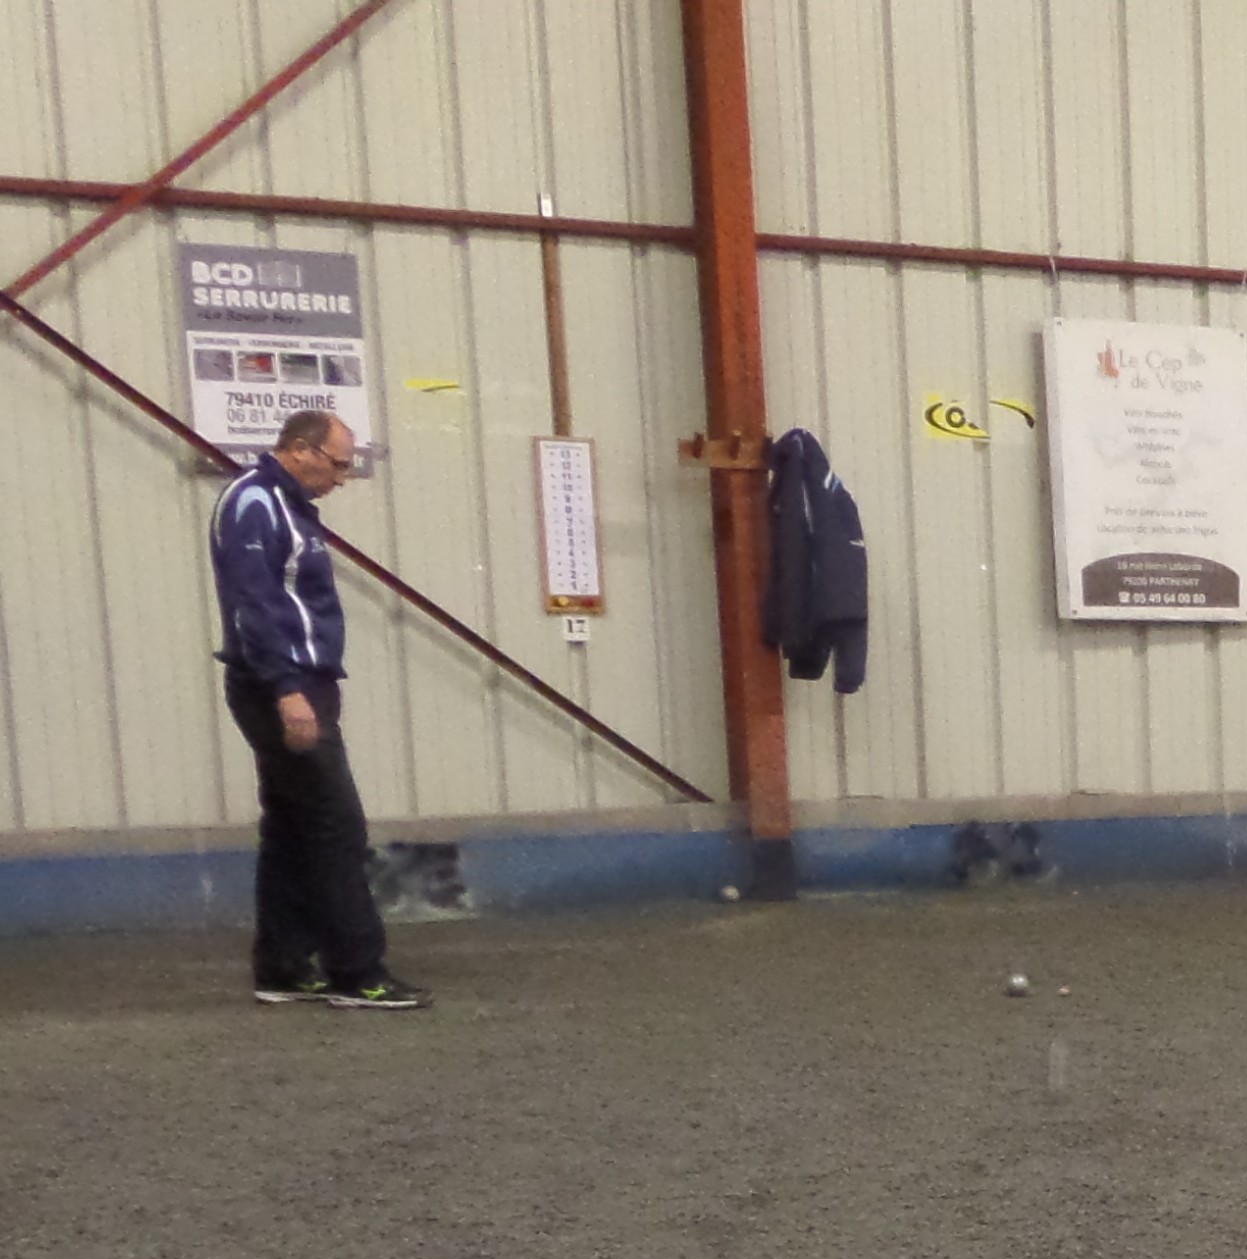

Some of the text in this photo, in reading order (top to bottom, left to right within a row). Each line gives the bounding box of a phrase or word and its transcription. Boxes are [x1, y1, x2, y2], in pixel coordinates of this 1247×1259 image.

[191, 260, 253, 286] BCD
[192, 287, 352, 314] SERRURERIE
[1119, 348, 1182, 374] Le Cep
[226, 391, 336, 410] 79410 ÉCHIRÉ
[227, 410, 246, 423] 06
[251, 410, 266, 424] 81
[1133, 593, 1146, 604] 05
[1149, 593, 1161, 603] 49
